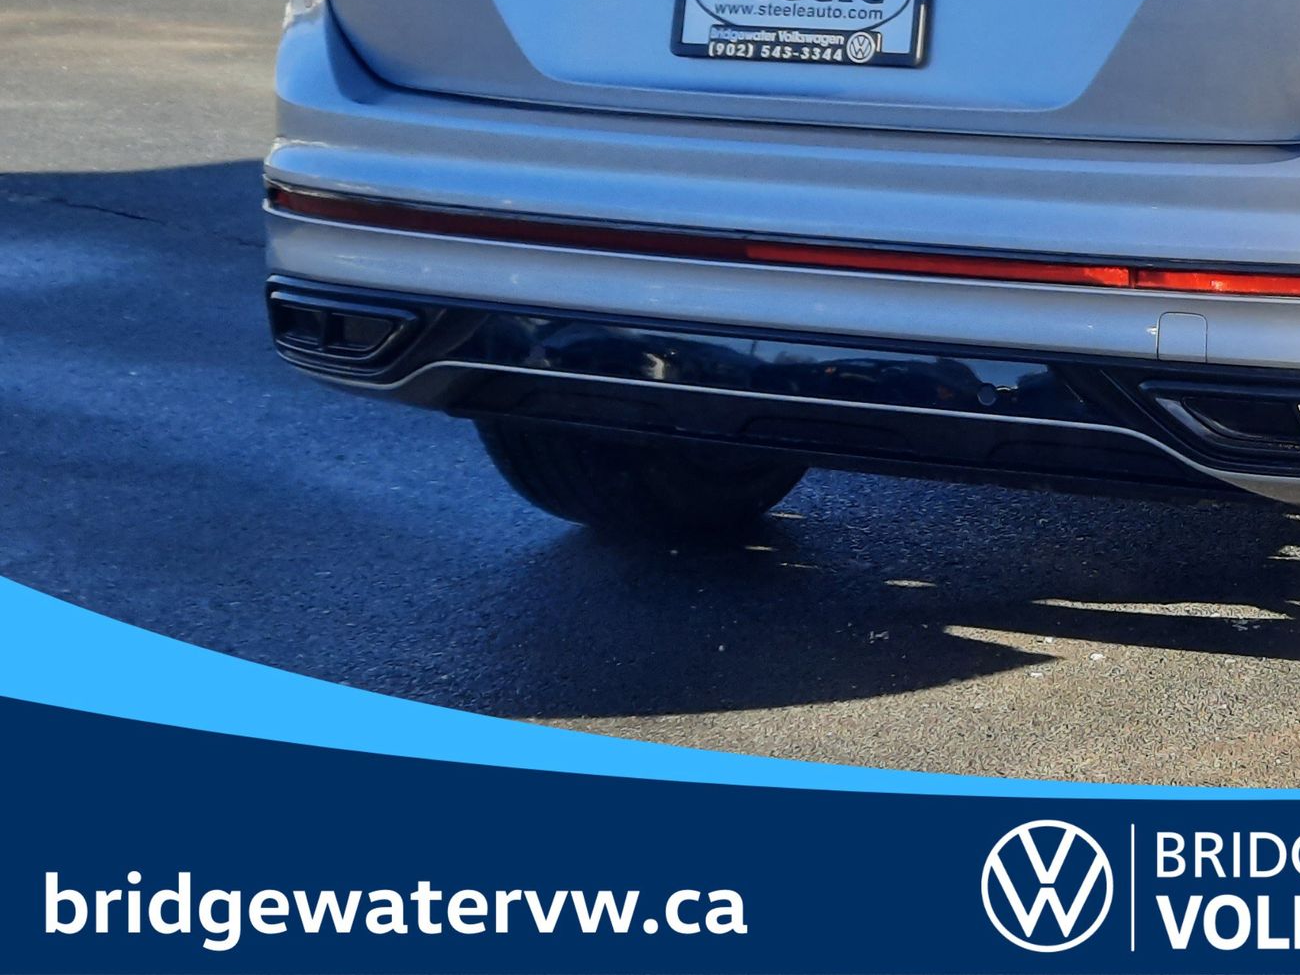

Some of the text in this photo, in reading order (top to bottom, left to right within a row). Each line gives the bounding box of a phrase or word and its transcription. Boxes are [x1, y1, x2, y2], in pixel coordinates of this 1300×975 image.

[714, 1, 883, 20] www.steeleauto.com
[778, 30, 845, 47] Volkswagen
[708, 41, 843, 62] (902) 543-3344
